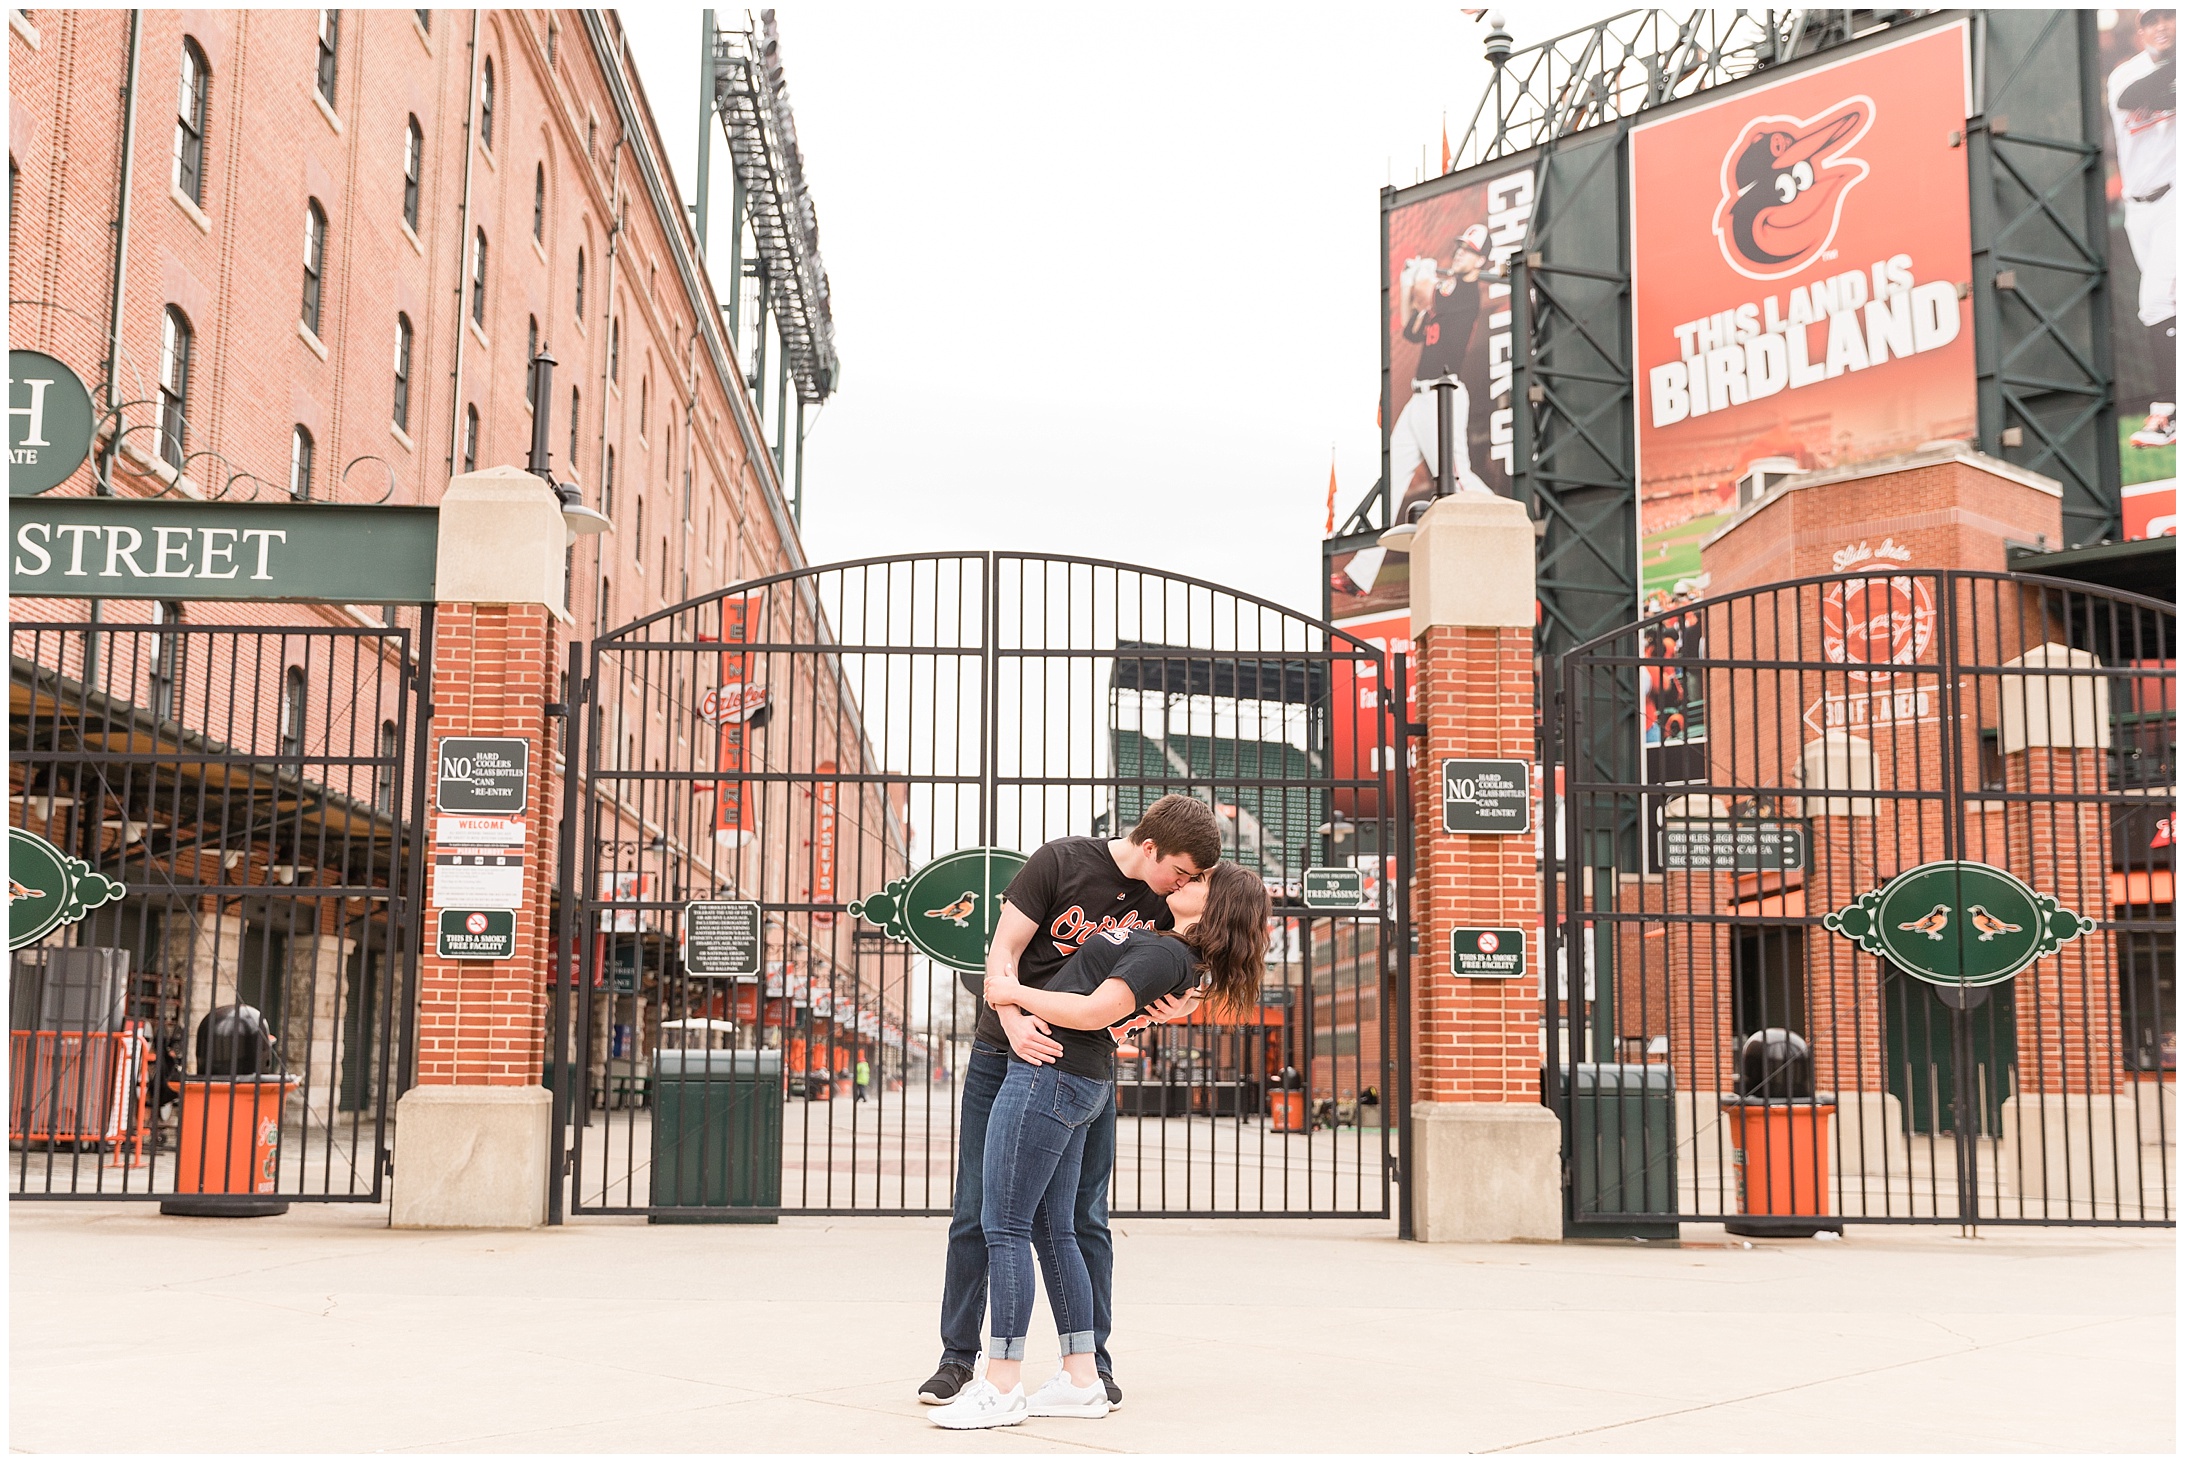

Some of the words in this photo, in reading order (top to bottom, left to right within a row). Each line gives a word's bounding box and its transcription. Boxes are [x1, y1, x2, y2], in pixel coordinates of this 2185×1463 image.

[1673, 302, 1761, 362] THIS
[1763, 270, 1868, 334] LAND
[1871, 253, 1914, 301] IS
[1649, 280, 1961, 429] BIRDLAND
[15, 522, 287, 580] STREET
[1833, 540, 1873, 572] Slide
[476, 752, 499, 760] HARD
[443, 757, 471, 778] NO
[475, 760, 511, 768] COOLERS
[475, 769, 496, 777] GLASS
[496, 769, 524, 777] BOTTLES
[475, 778, 495, 786] CANS
[1478, 781, 1514, 789] COOLERS
[475, 788, 513, 796] RE-ENTRY
[1447, 779, 1475, 799] NO
[1478, 799, 1499, 807] CANS
[1479, 809, 1517, 817] RE-ENTRY
[459, 820, 504, 829] WELCOME
[1713, 845, 1744, 854] PICNC
[1326, 880, 1340, 889] NO
[1307, 890, 1360, 898] TRESPASSING
[1050, 905, 1156, 945] Orioles
[480, 935, 507, 943] SMOKE
[448, 942, 468, 950] FREE
[469, 942, 503, 950] FACILITY
[1482, 961, 1515, 969] FACILITY
